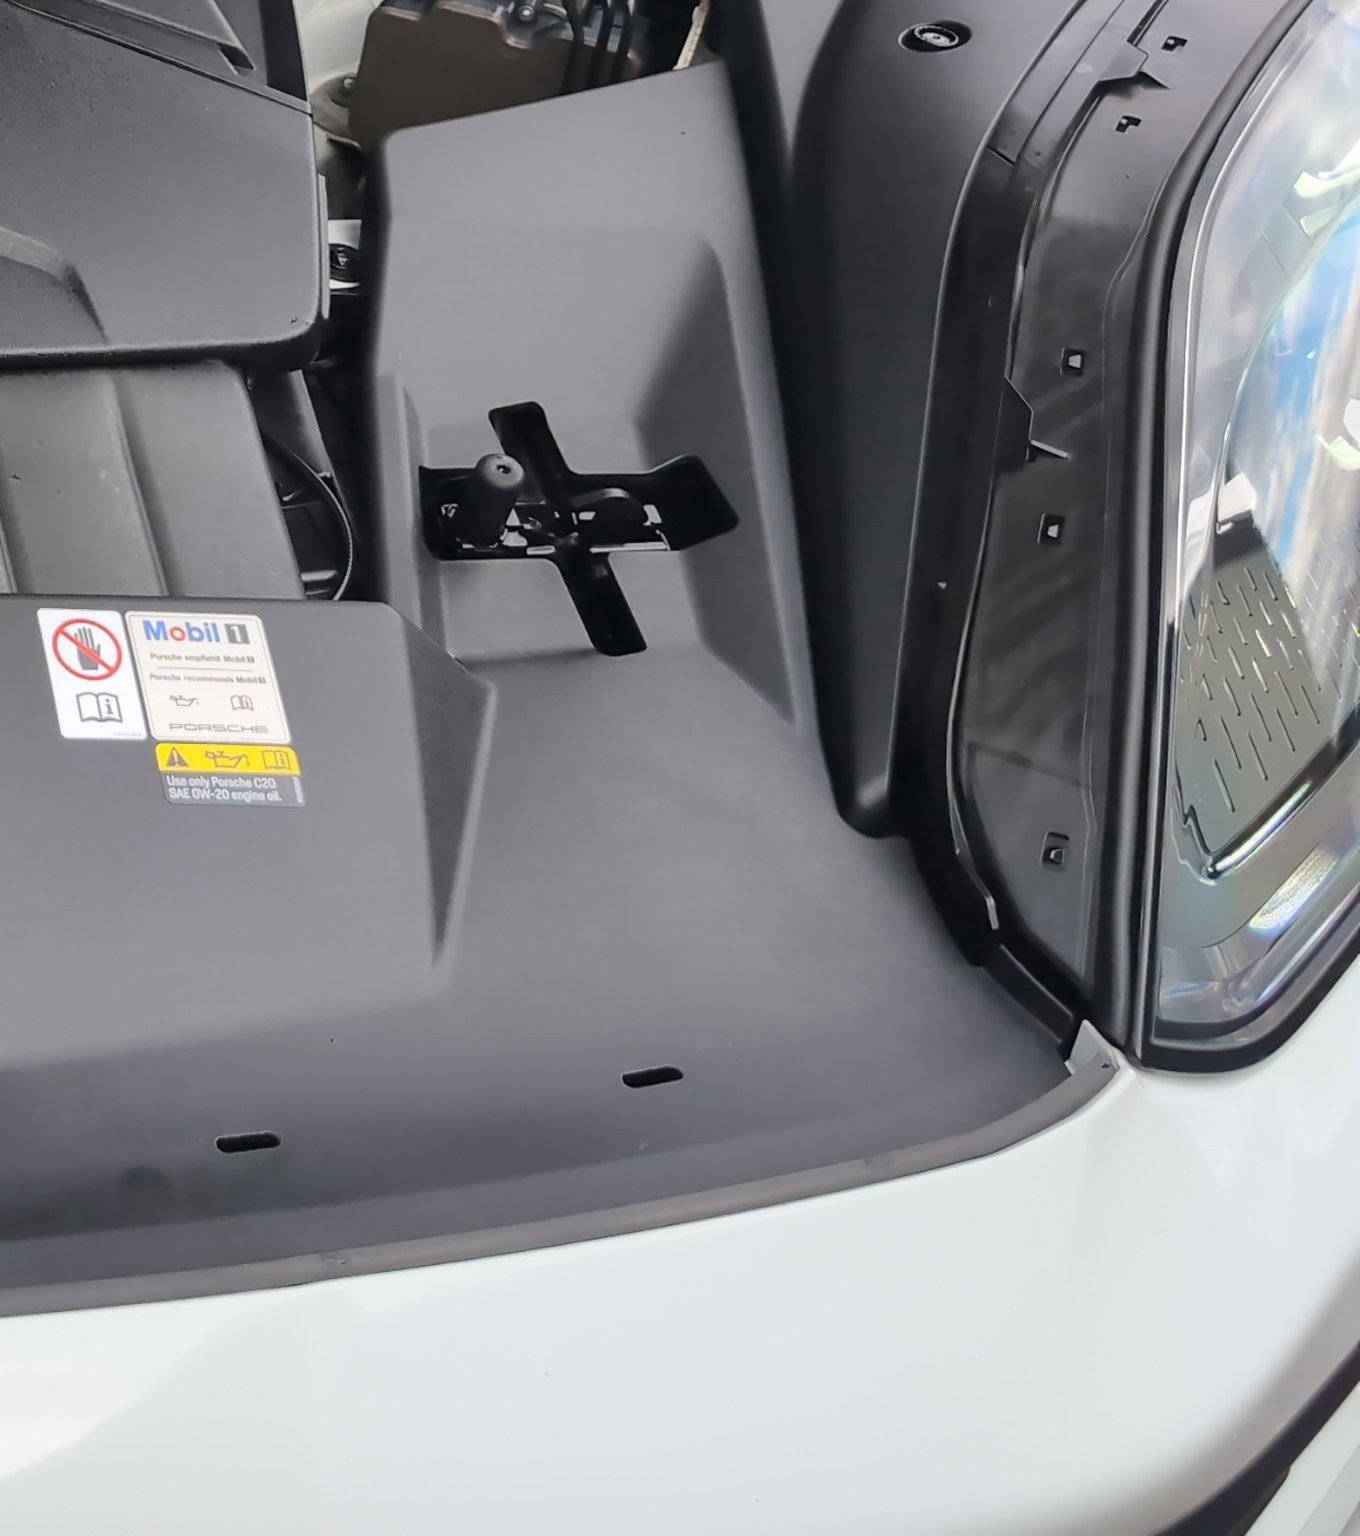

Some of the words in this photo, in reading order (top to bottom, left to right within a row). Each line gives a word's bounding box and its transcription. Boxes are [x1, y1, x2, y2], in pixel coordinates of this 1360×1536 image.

[142, 620, 220, 643] Mobil
[150, 652, 182, 662] Porsche
[149, 673, 181, 683] Porsche
[183, 675, 234, 684] recommends
[169, 723, 268, 733] PORSCHE
[166, 775, 187, 787] Use
[188, 776, 210, 791] only
[211, 776, 253, 789] Porsche
[254, 777, 276, 789] C20
[169, 788, 190, 799] SAE
[191, 789, 229, 800] 0W-20
[231, 790, 265, 804] engine
